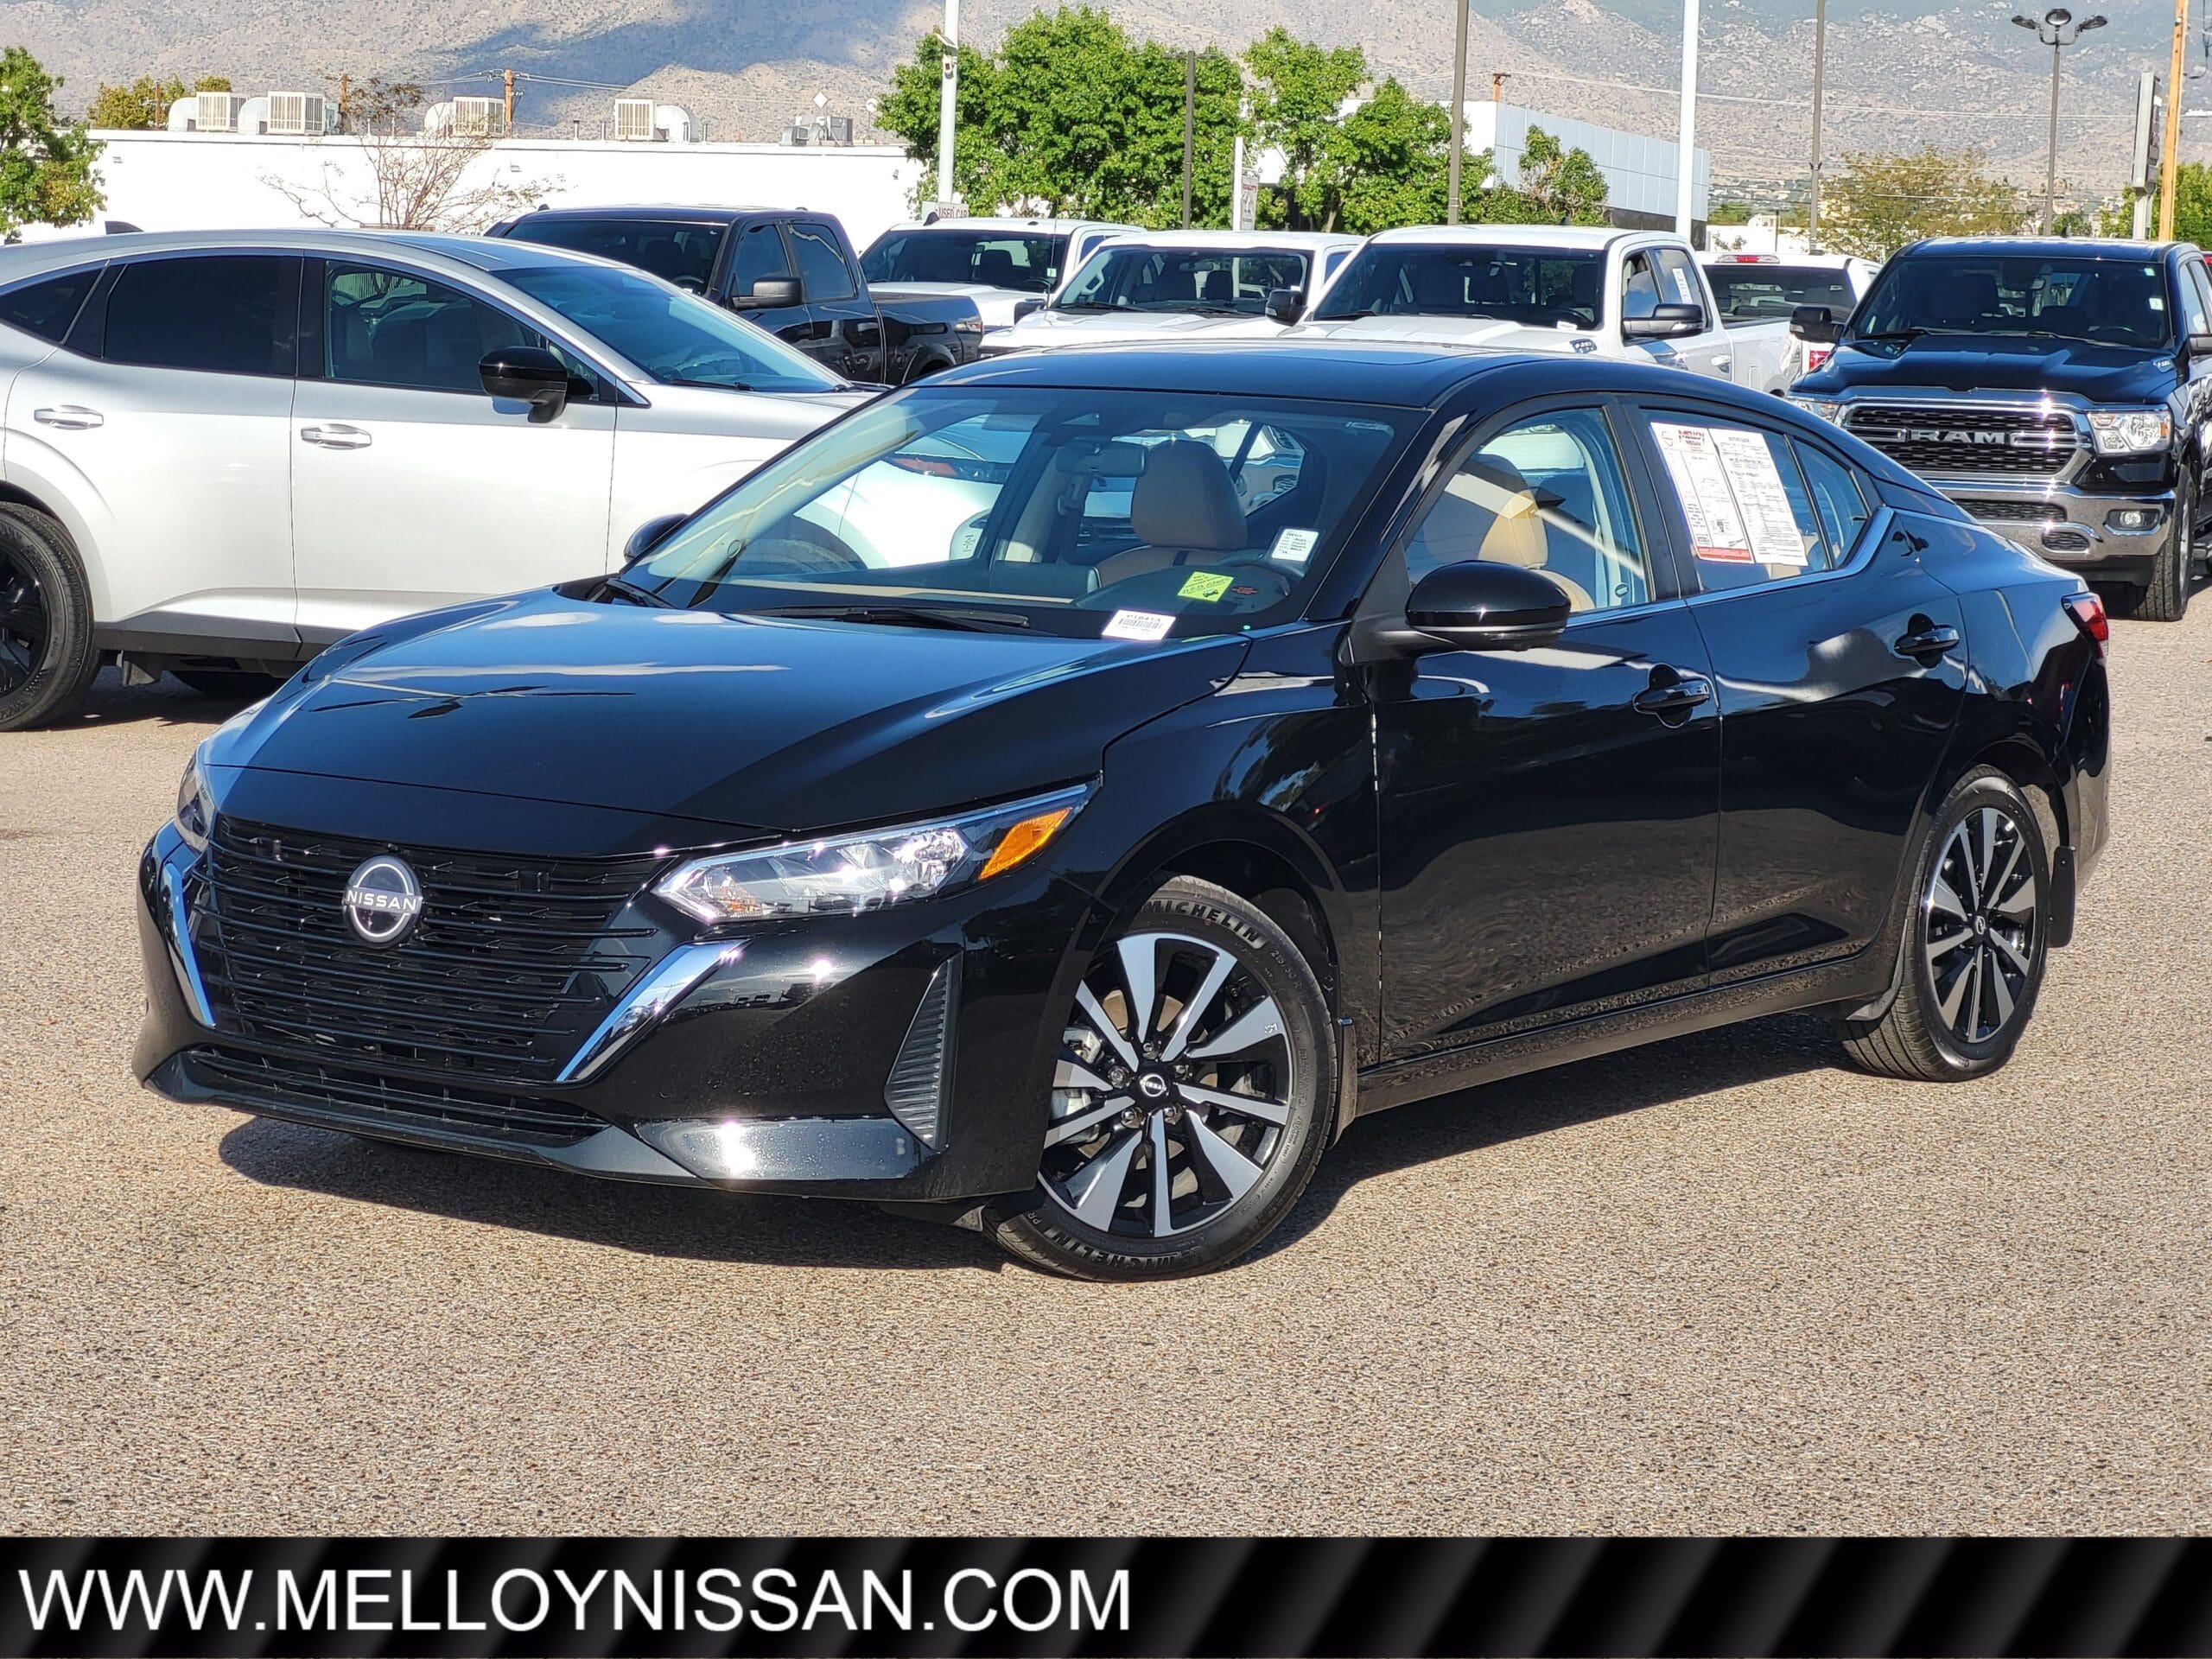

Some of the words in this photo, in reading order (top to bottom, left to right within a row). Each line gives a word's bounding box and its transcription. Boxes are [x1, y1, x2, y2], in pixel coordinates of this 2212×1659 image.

[1910, 429, 2005, 444] RAM
[346, 889, 417, 911] NISSAN
[1142, 899, 1261, 942] MICHELIN
